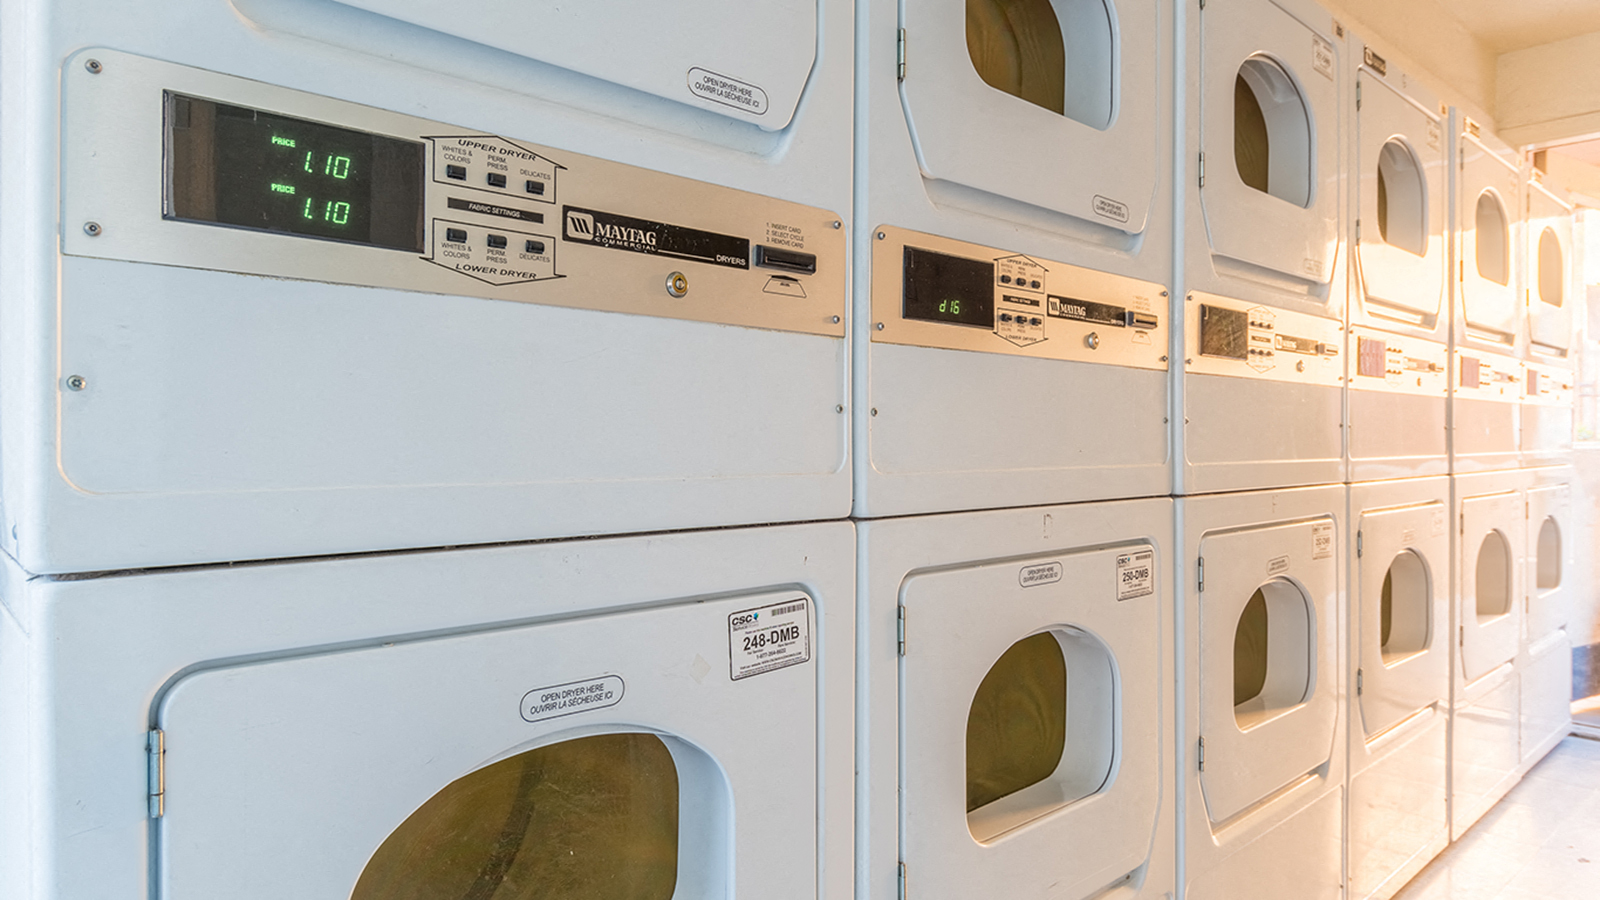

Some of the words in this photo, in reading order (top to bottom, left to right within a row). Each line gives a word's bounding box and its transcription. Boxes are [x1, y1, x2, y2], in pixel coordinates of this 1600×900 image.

[695, 82, 716, 94] OUVRIR
[703, 76, 719, 87] OPEN
[720, 81, 738, 92] DRYER
[739, 86, 752, 97] HERE
[271, 136, 296, 148] PRICE
[442, 145, 467, 156] WHITES
[458, 139, 497, 152] UPPER
[499, 148, 537, 161] DRYER
[444, 153, 471, 164] COLORS
[304, 151, 350, 180] 1.10
[487, 162, 508, 171] PRESS
[520, 168, 551, 180] DELICATES
[271, 183, 295, 195] PRICE
[304, 198, 350, 224] 1.10
[468, 203, 491, 213] FABRIC
[492, 207, 521, 218] SETTINGS
[595, 222, 657, 246] MAYTAG
[441, 242, 467, 251] WHITES
[594, 237, 656, 251] COMMERCIAL
[771, 237, 790, 246] REMOVE
[443, 250, 470, 260] COLORS
[486, 256, 508, 264] PRESS
[519, 253, 550, 263] DELICATES
[716, 254, 746, 266] DRYERS
[456, 264, 497, 275] LOWER
[500, 270, 537, 279] DRYER
[1060, 303, 1086, 316] MAYTAG
[732, 614, 752, 625] CSC
[743, 626, 799, 651] 248-DMB
[541, 692, 560, 703] OPEN
[562, 687, 585, 698] DRYER
[586, 683, 604, 694] HERE
[530, 702, 557, 714] OUVRIR
[558, 700, 566, 709] LA
[604, 691, 613, 699] ICI
